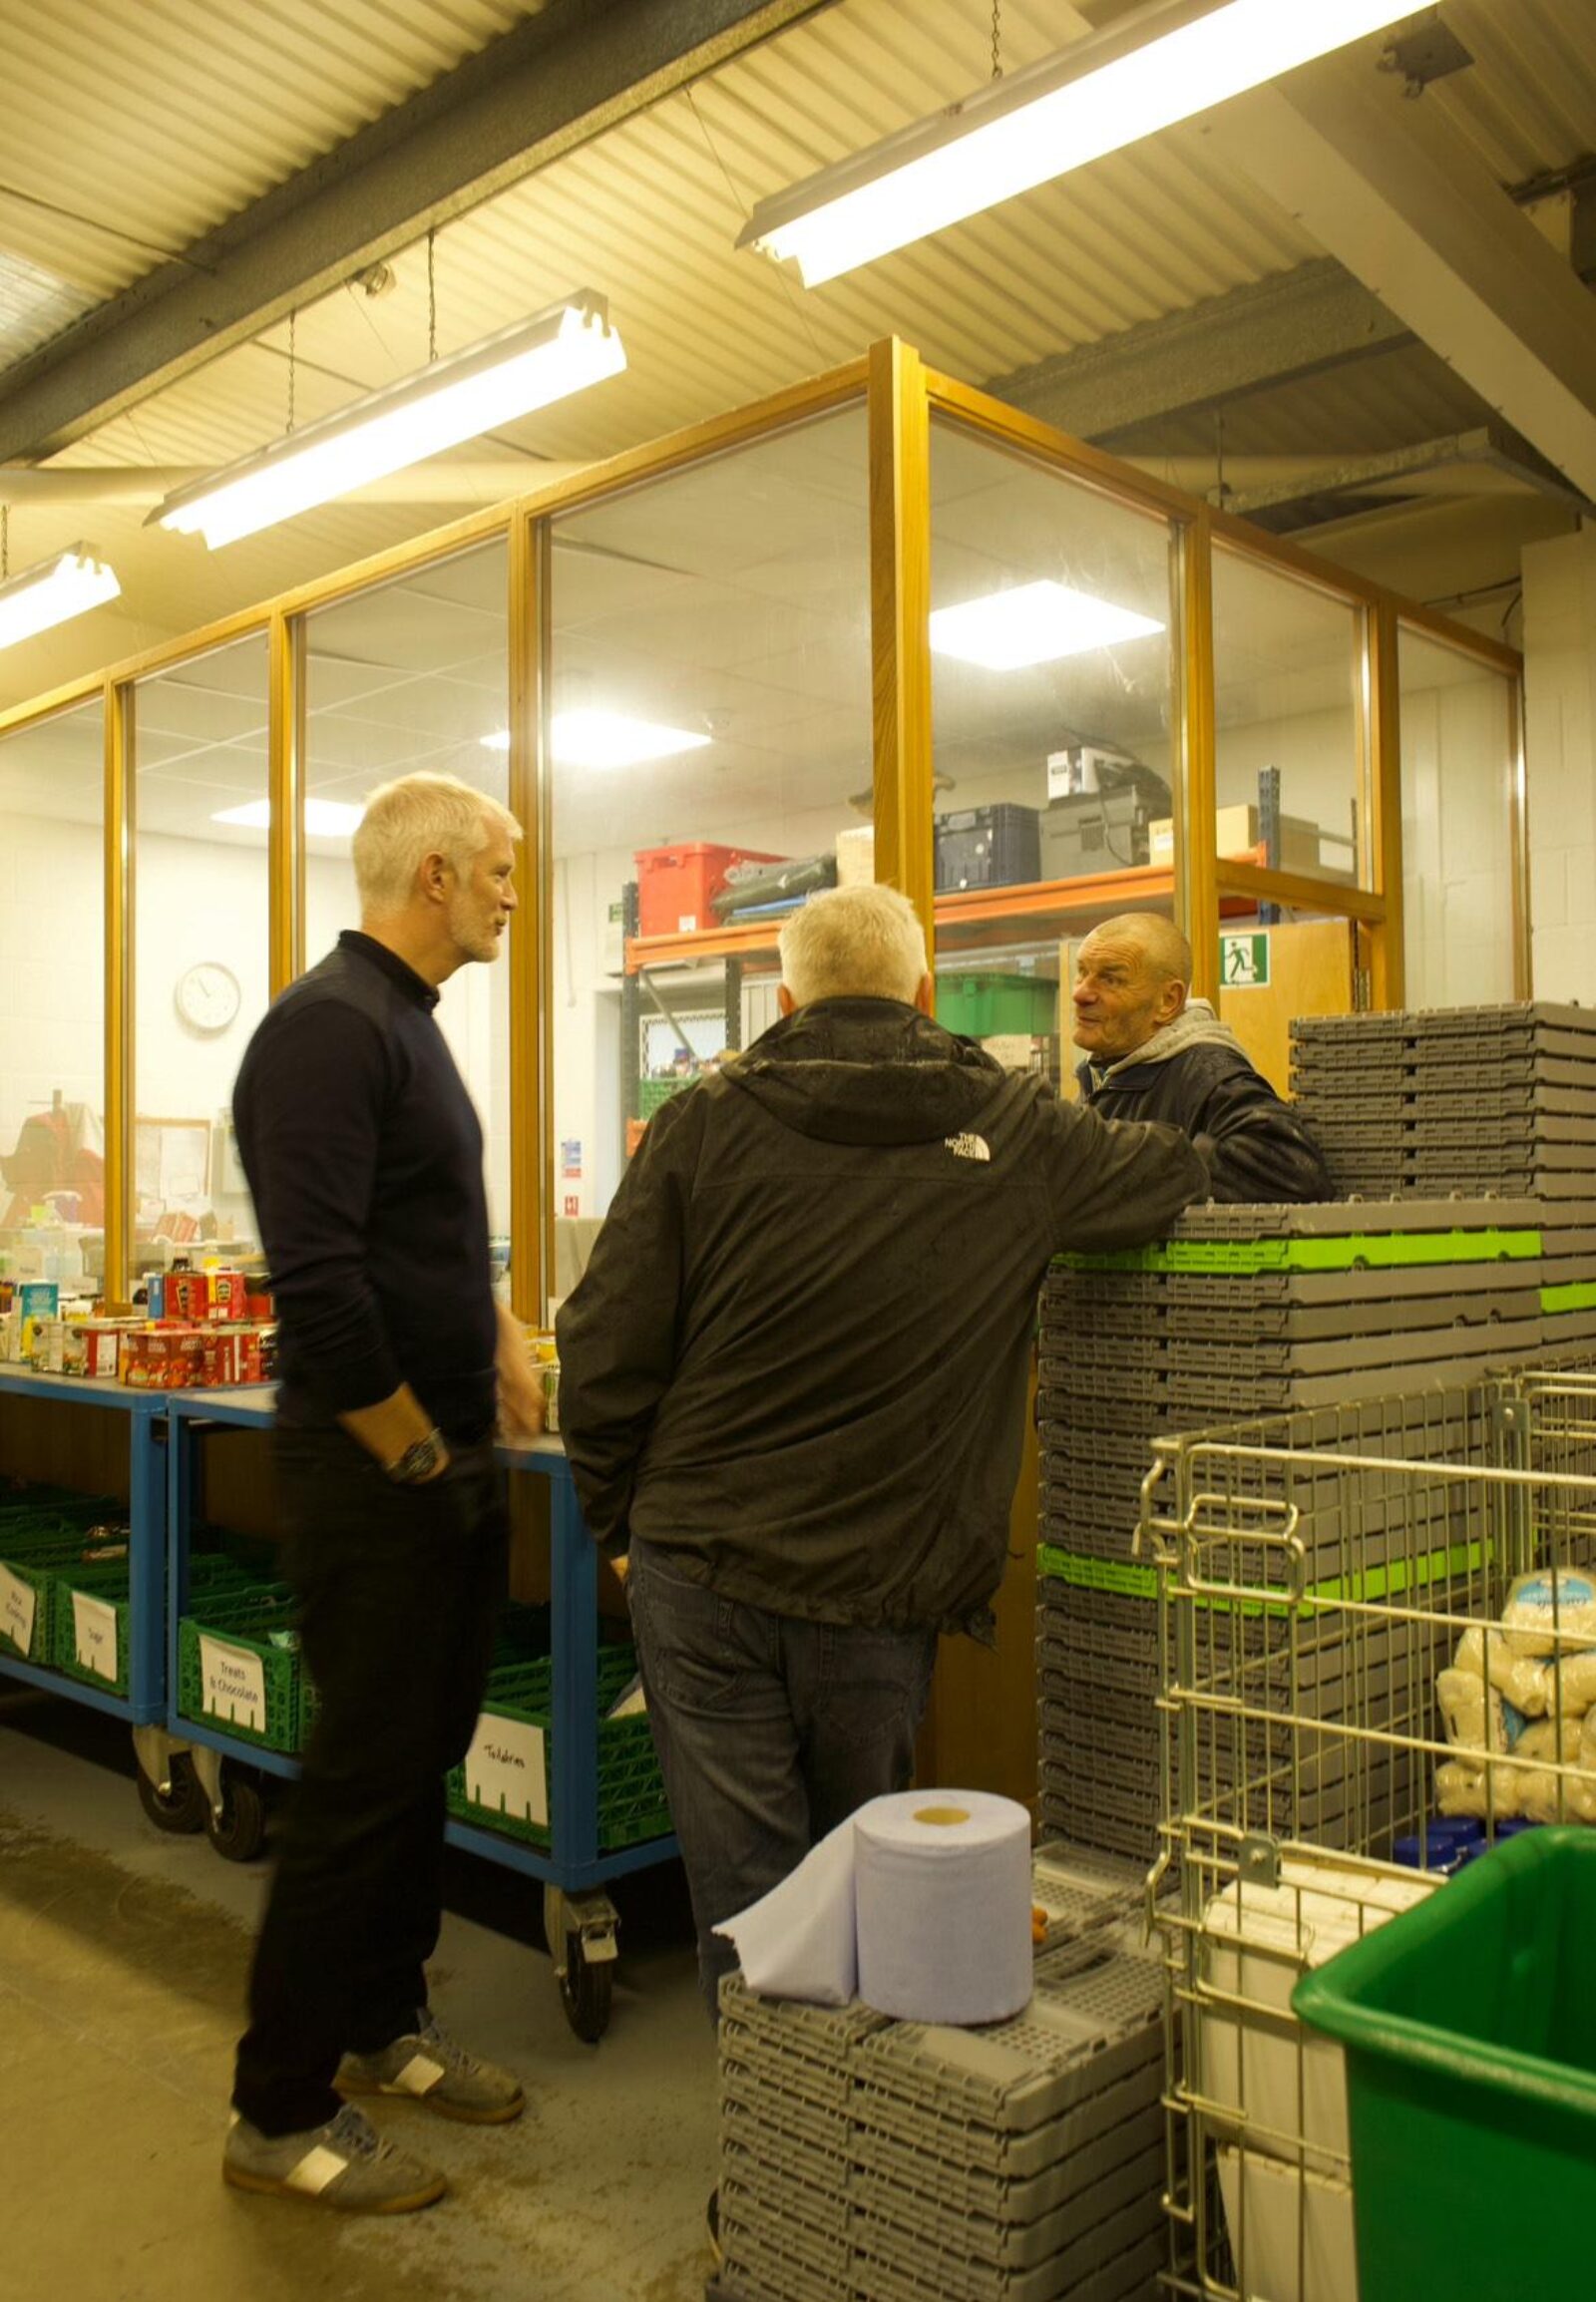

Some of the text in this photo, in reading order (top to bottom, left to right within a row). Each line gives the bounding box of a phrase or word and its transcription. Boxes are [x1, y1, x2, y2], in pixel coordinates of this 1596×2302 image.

[959, 1132, 975, 1142] THE
[945, 1138, 975, 1150] NORTH
[954, 1147, 976, 1158] FACE
[220, 1662, 246, 1681] Treats
[217, 1679, 258, 1704] Chocolate
